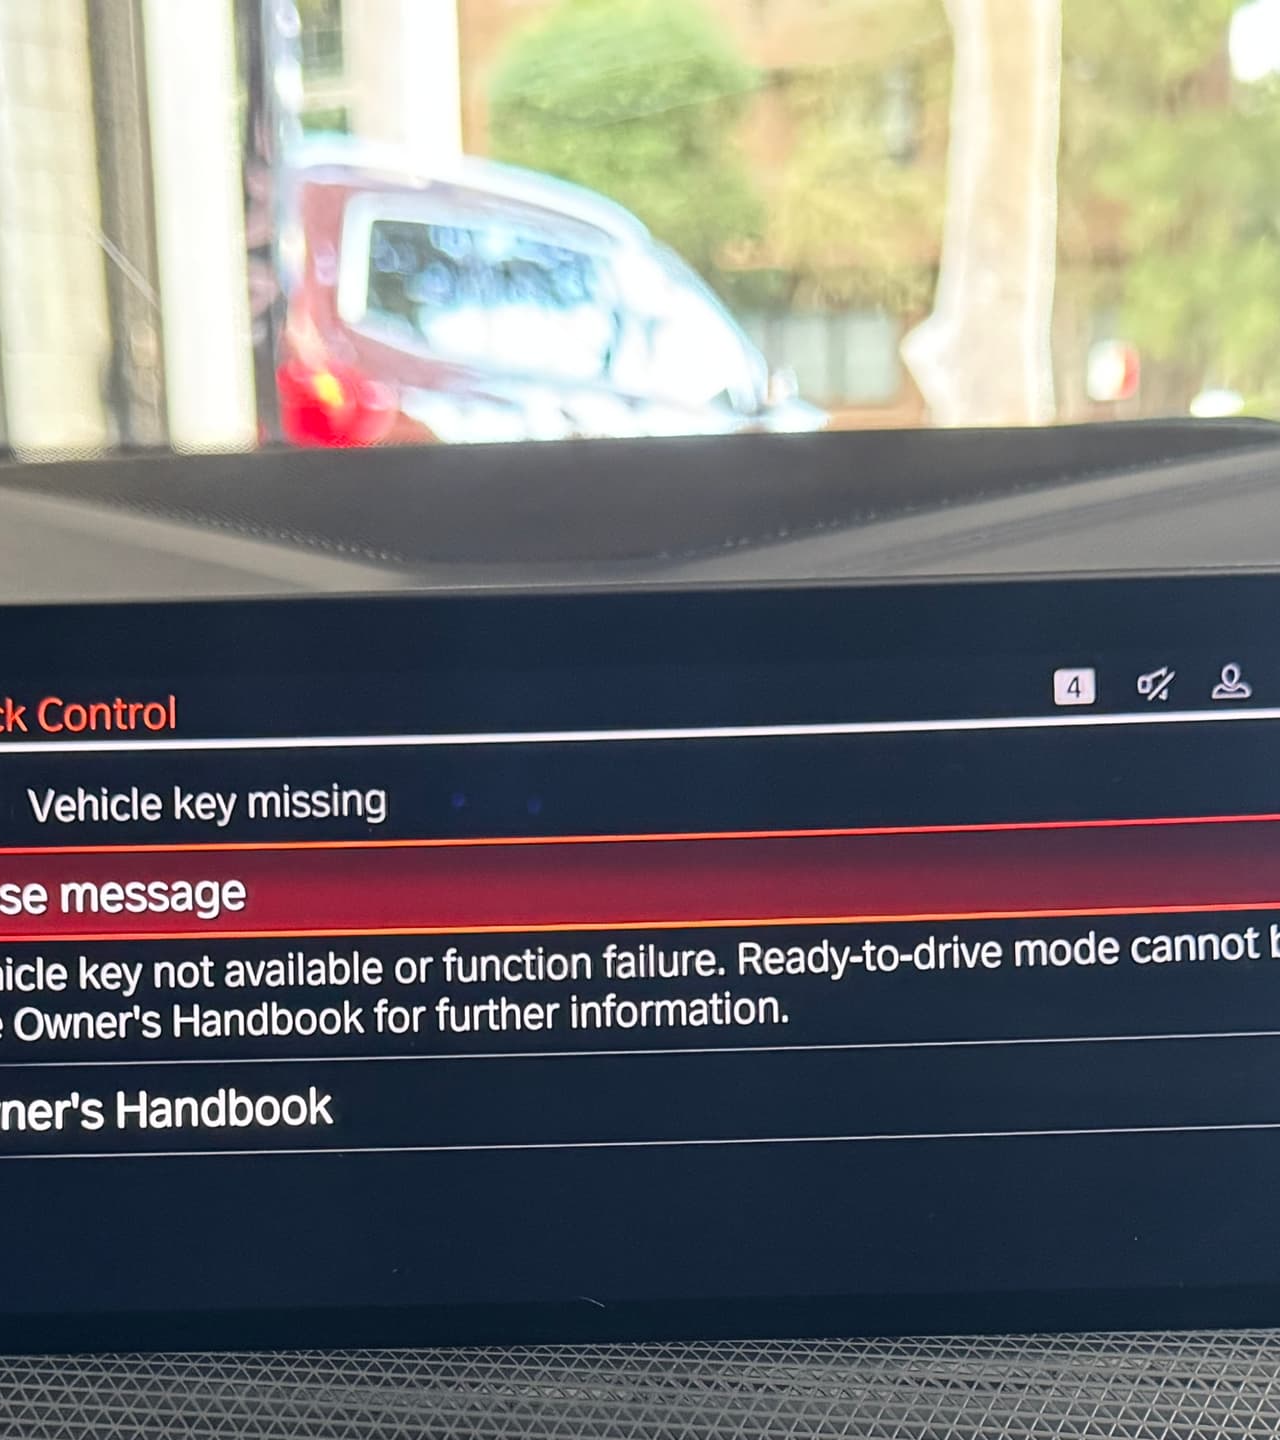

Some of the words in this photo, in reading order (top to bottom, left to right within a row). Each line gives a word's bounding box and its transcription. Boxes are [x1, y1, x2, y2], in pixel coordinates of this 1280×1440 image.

[1067, 676, 1081, 698] 4
[37, 694, 176, 733] Control
[27, 786, 163, 823] Vehicle
[174, 785, 238, 827] key
[248, 782, 386, 824] missing
[60, 879, 247, 920] message
[79, 955, 143, 997] key
[153, 955, 215, 989] not
[224, 950, 384, 988] available
[394, 956, 434, 984] or
[441, 946, 592, 983] function
[602, 943, 725, 979] failure.
[738, 934, 1003, 981] Ready-to-drive
[1014, 930, 1120, 967] mode
[1131, 926, 1261, 964] cannot
[13, 1004, 162, 1042] Owner's
[173, 999, 365, 1038] Handbook
[373, 998, 427, 1034] for
[435, 996, 561, 1033] further
[571, 990, 789, 1029] information.
[116, 1085, 334, 1129] Handbook
